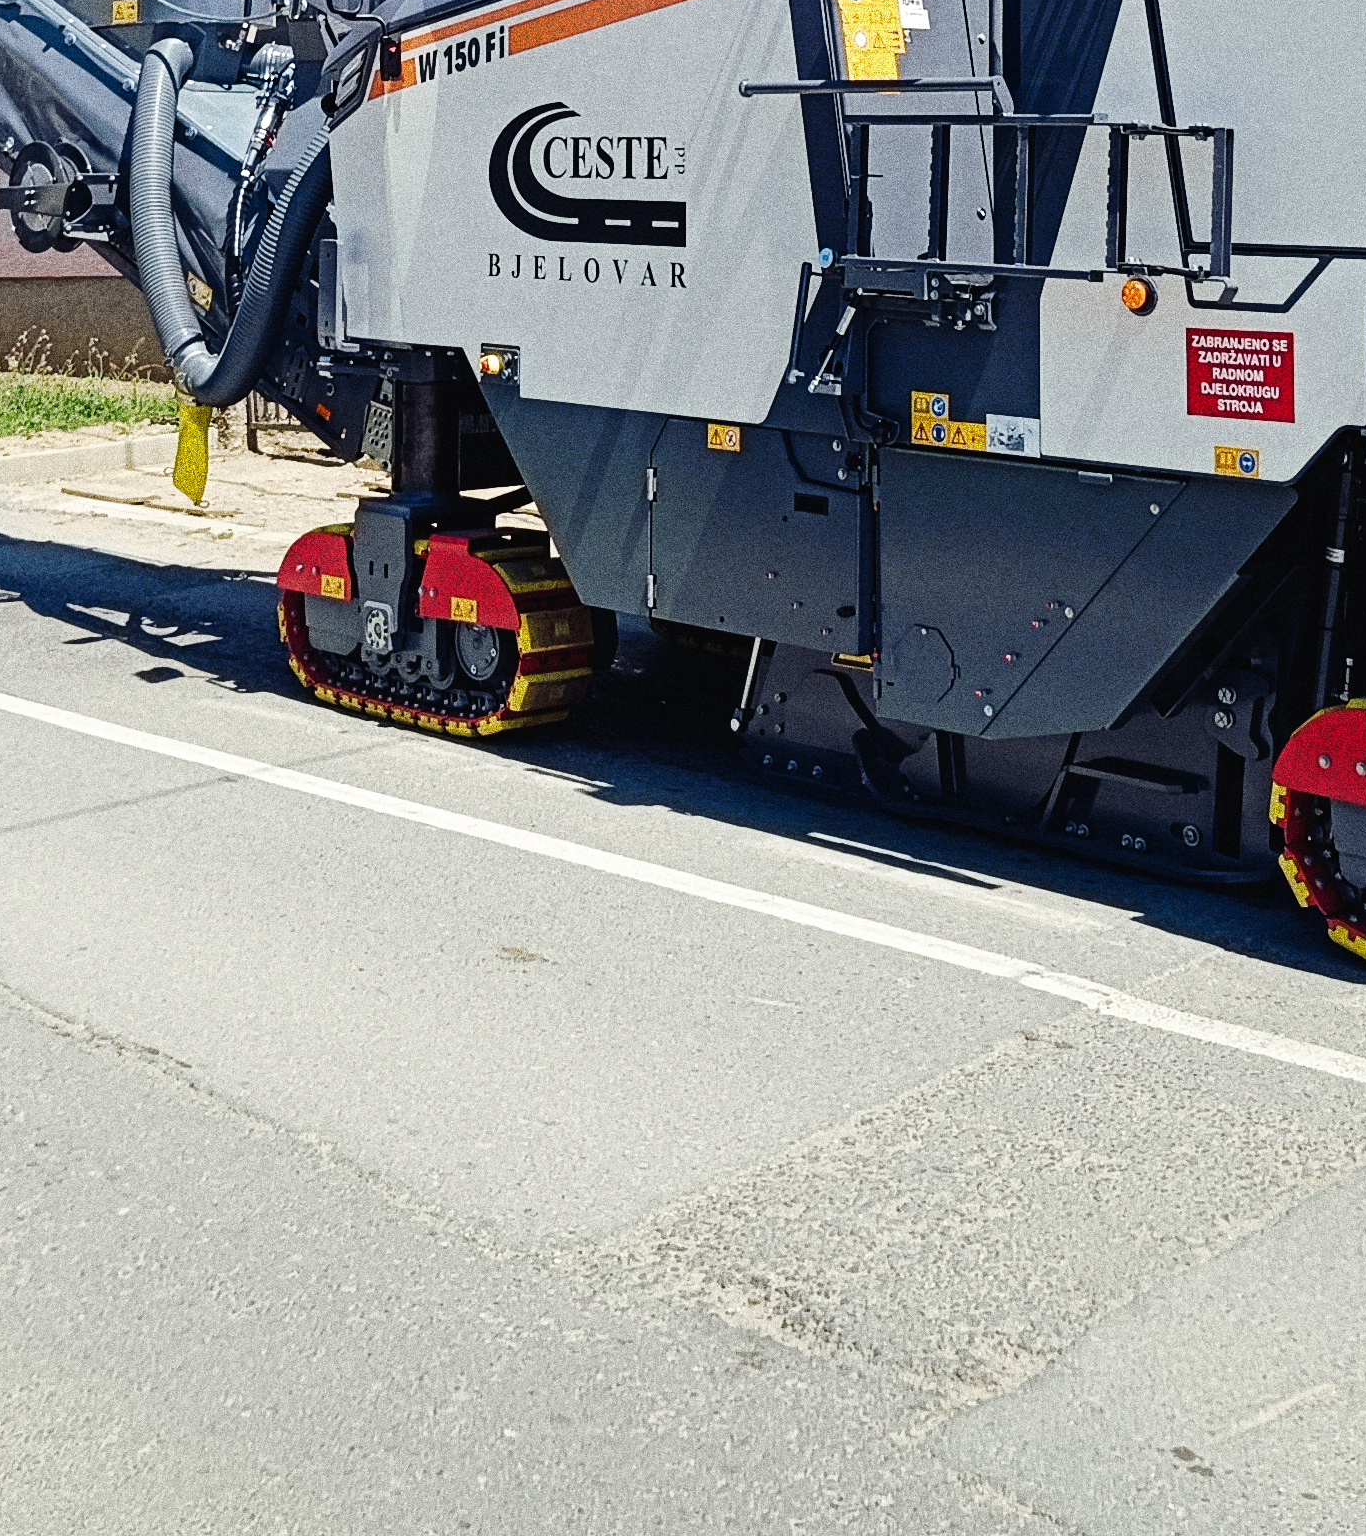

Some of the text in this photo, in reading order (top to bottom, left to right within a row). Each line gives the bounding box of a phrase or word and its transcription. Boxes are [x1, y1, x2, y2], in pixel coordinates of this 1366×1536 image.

[419, 25, 505, 83] W 150 Fi
[543, 136, 669, 179] CESTE
[488, 253, 687, 288] BJELOVAR
[1192, 336, 1288, 352] ZABRANJENO SE
[1198, 350, 1282, 368] ZADRŽAVATI U
[1212, 367, 1264, 382] RADNOM
[1201, 382, 1280, 399] DJELOKRUGU
[1217, 398, 1263, 414] STROJA
